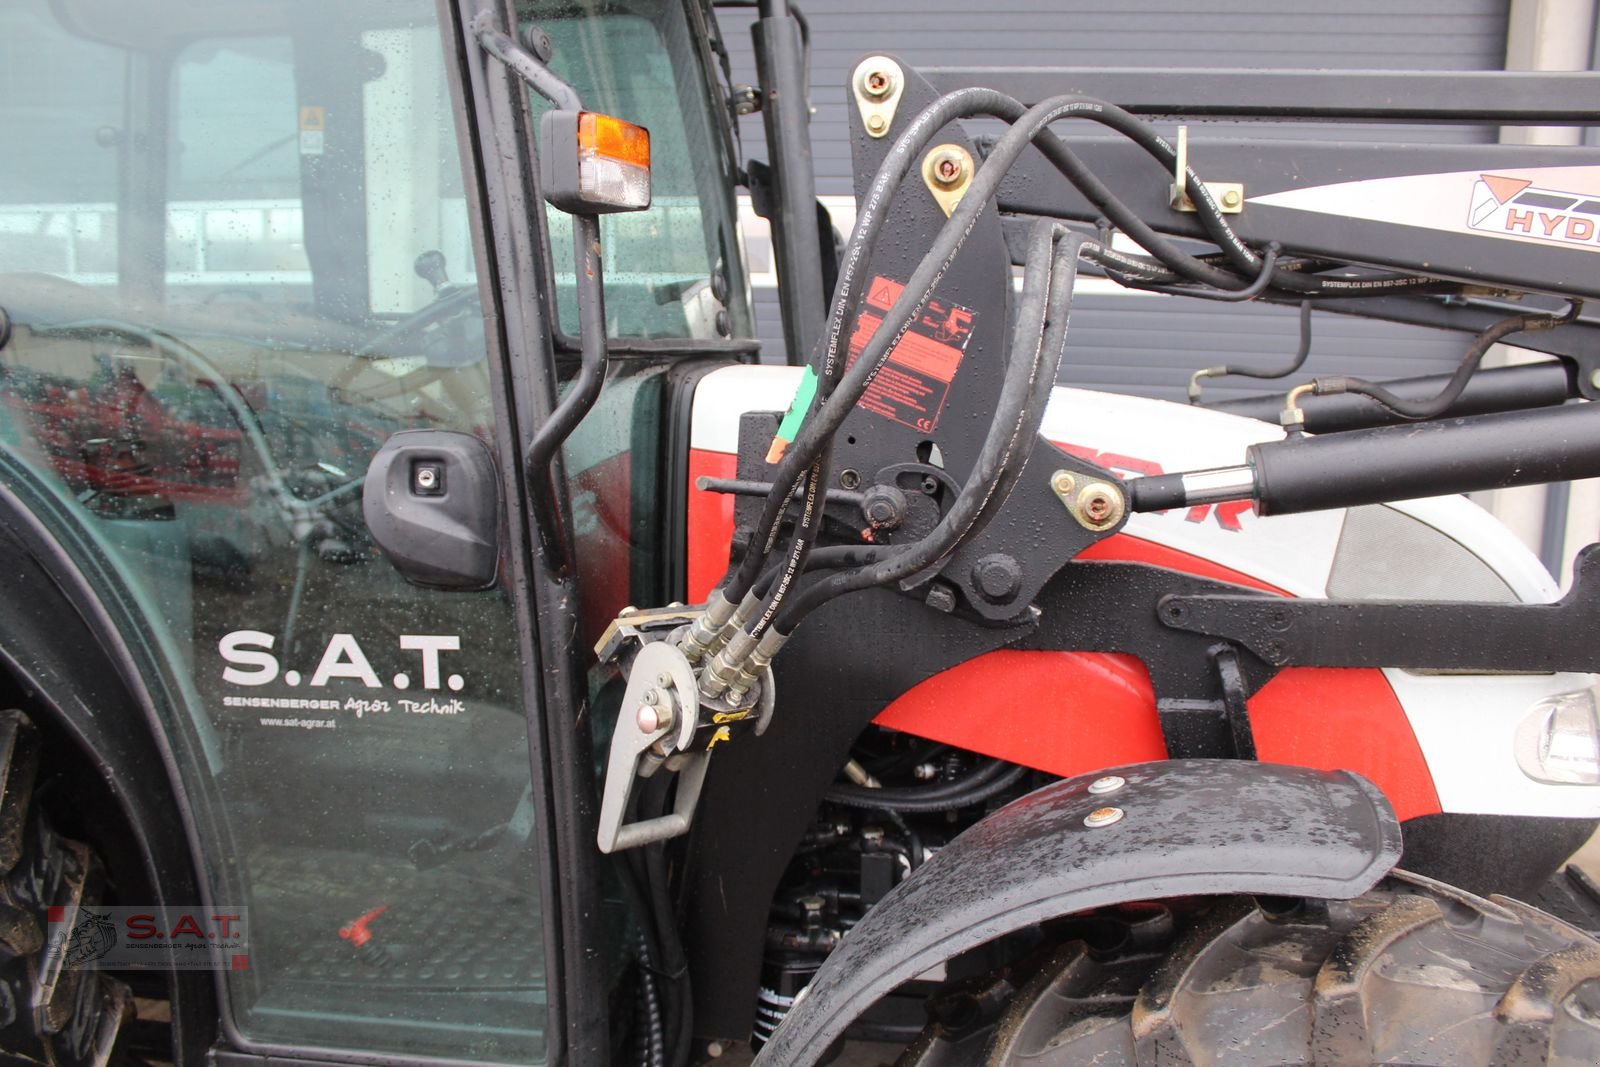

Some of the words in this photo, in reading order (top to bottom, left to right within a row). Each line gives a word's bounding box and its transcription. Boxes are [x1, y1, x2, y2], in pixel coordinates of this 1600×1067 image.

[861, 211, 872, 226] WP
[1504, 208, 1600, 242] HYD
[857, 228, 867, 240] 12
[841, 282, 850, 298] EN
[825, 317, 843, 375] SYSTEMFLEX
[218, 629, 465, 691] S.A.T.
[223, 696, 340, 710] SENSENBERGER
[344, 698, 392, 718] Agrar
[397, 698, 466, 714] Technik
[260, 717, 336, 729] www.sat-agrar.at
